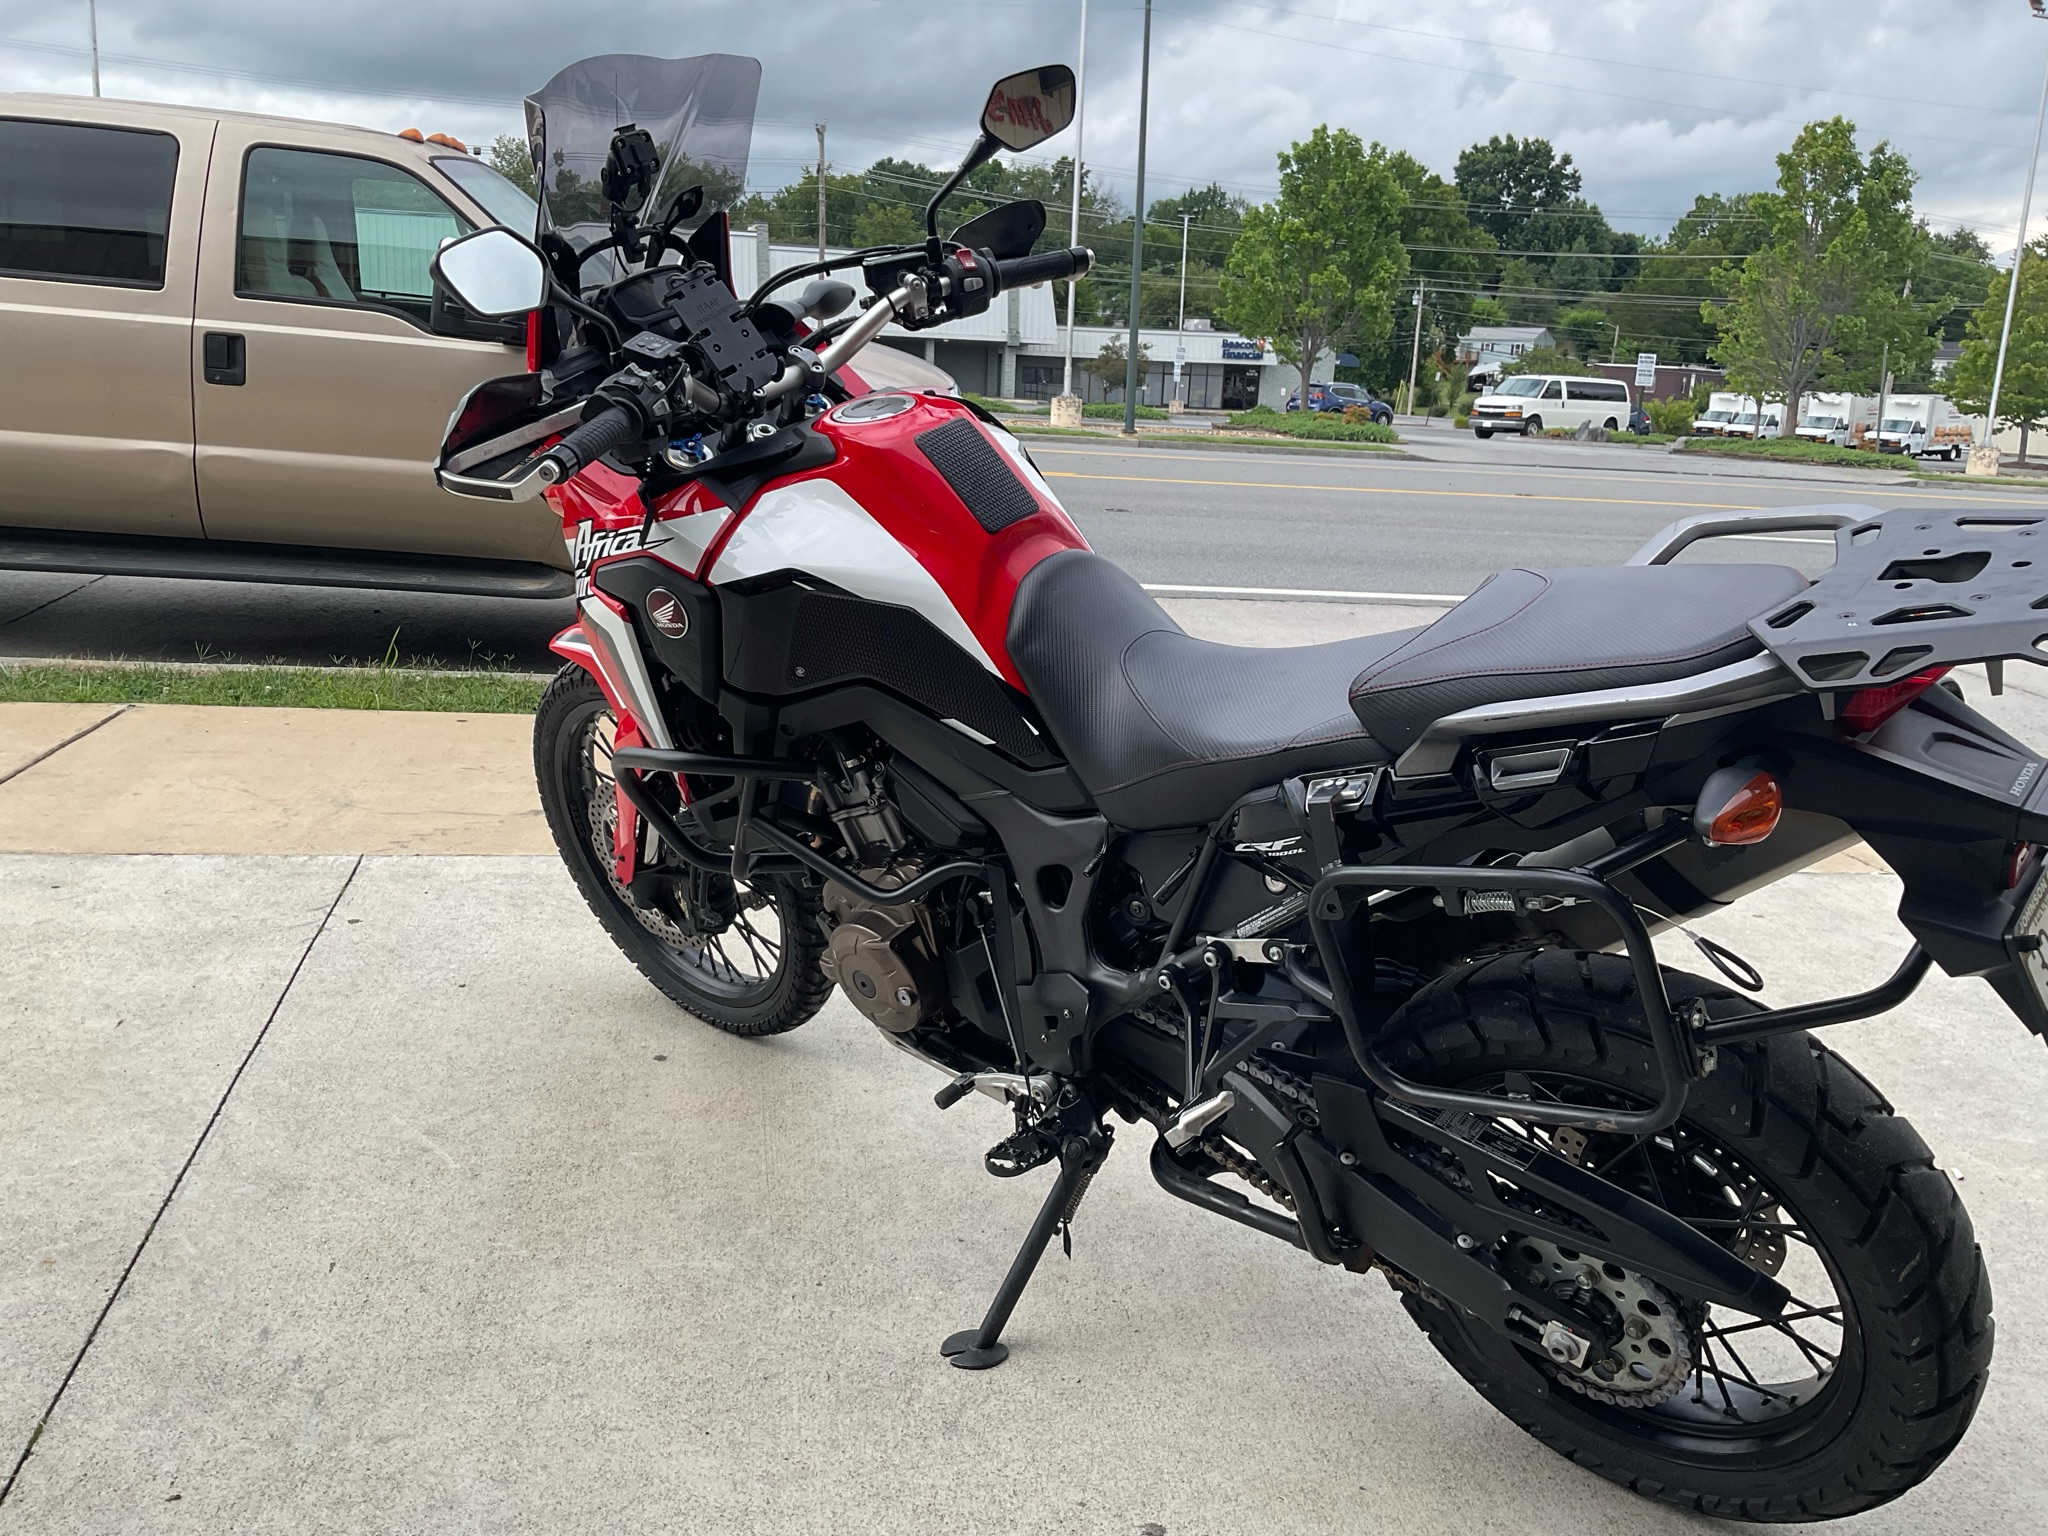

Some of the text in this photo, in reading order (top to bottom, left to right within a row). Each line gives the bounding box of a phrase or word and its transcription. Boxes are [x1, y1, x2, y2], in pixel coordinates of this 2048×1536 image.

[1222, 349, 1264, 359] Financial
[574, 518, 652, 570] Africa
[2009, 762, 2039, 797] HONDA
[1235, 835, 1302, 852] CRF
[2020, 878, 2048, 934] JOHNSON
